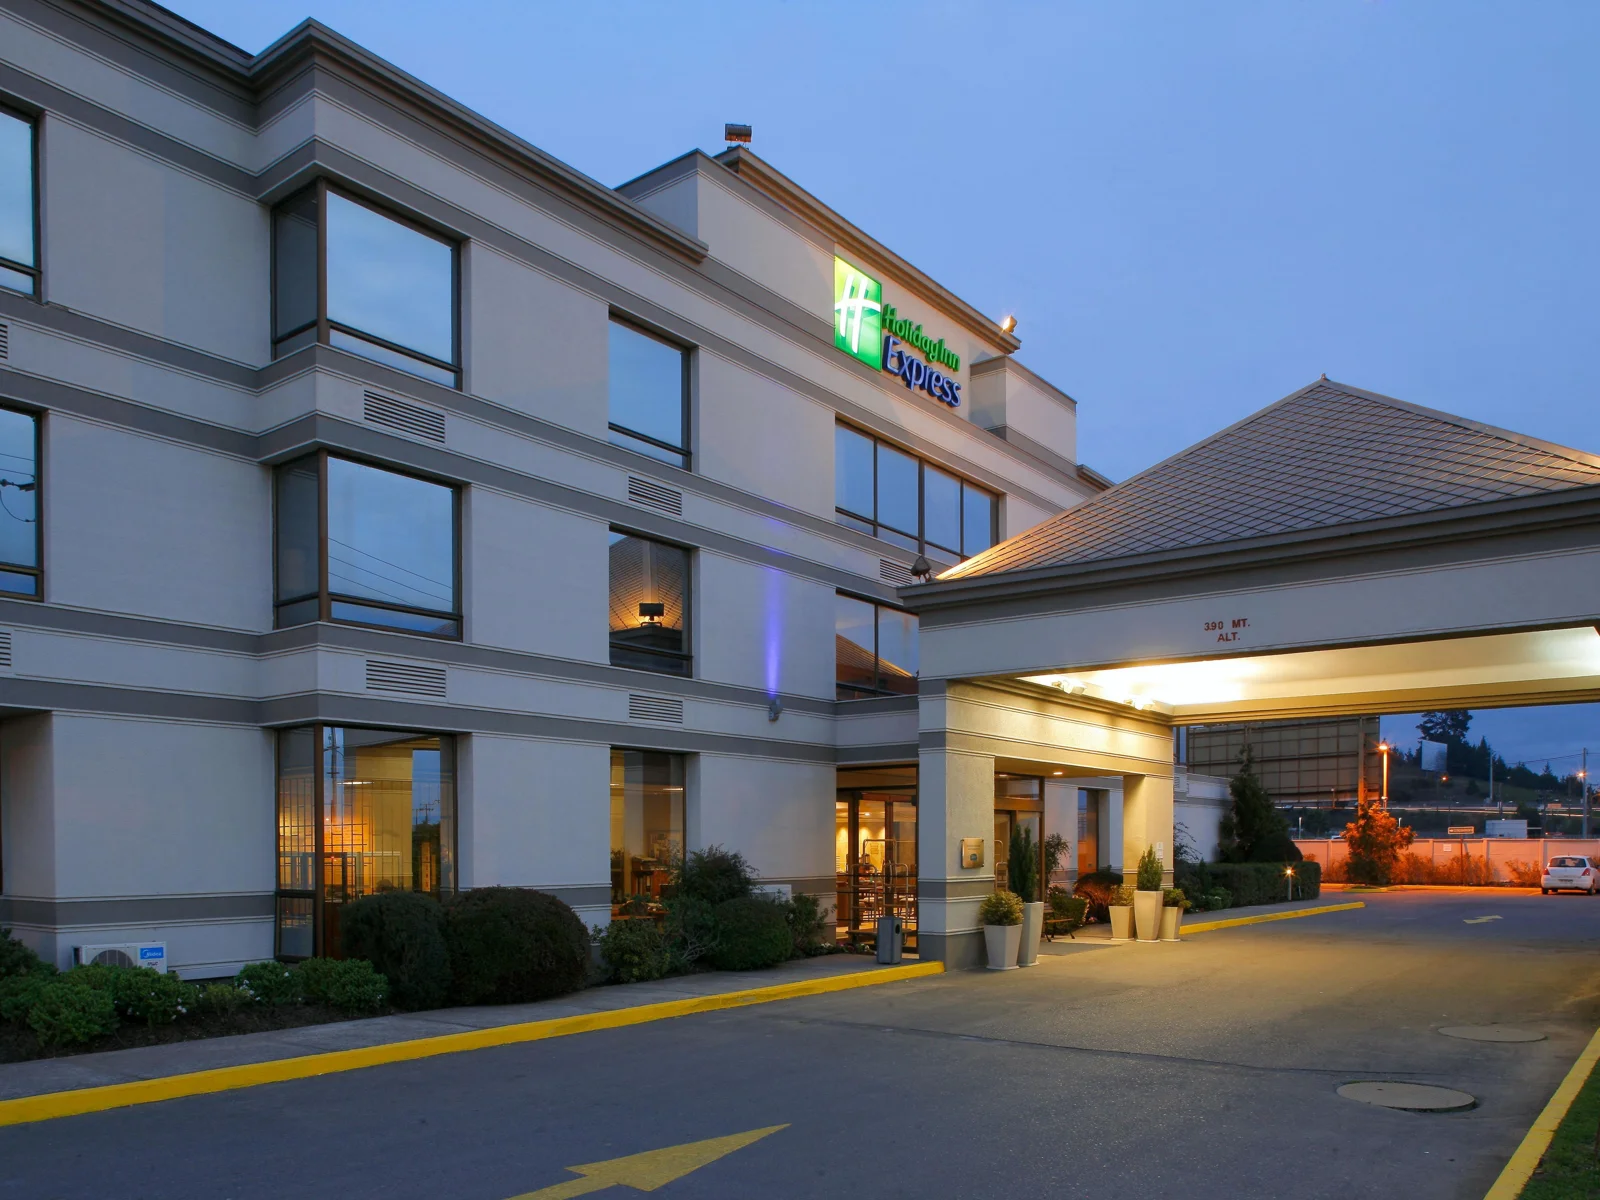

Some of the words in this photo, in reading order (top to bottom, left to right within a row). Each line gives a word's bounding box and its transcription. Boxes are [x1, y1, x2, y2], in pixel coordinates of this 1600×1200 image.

[938, 338, 960, 372] Inn
[882, 335, 961, 407] Express
[1232, 618, 1250, 628] MT.
[1217, 632, 1241, 642] ALT.
